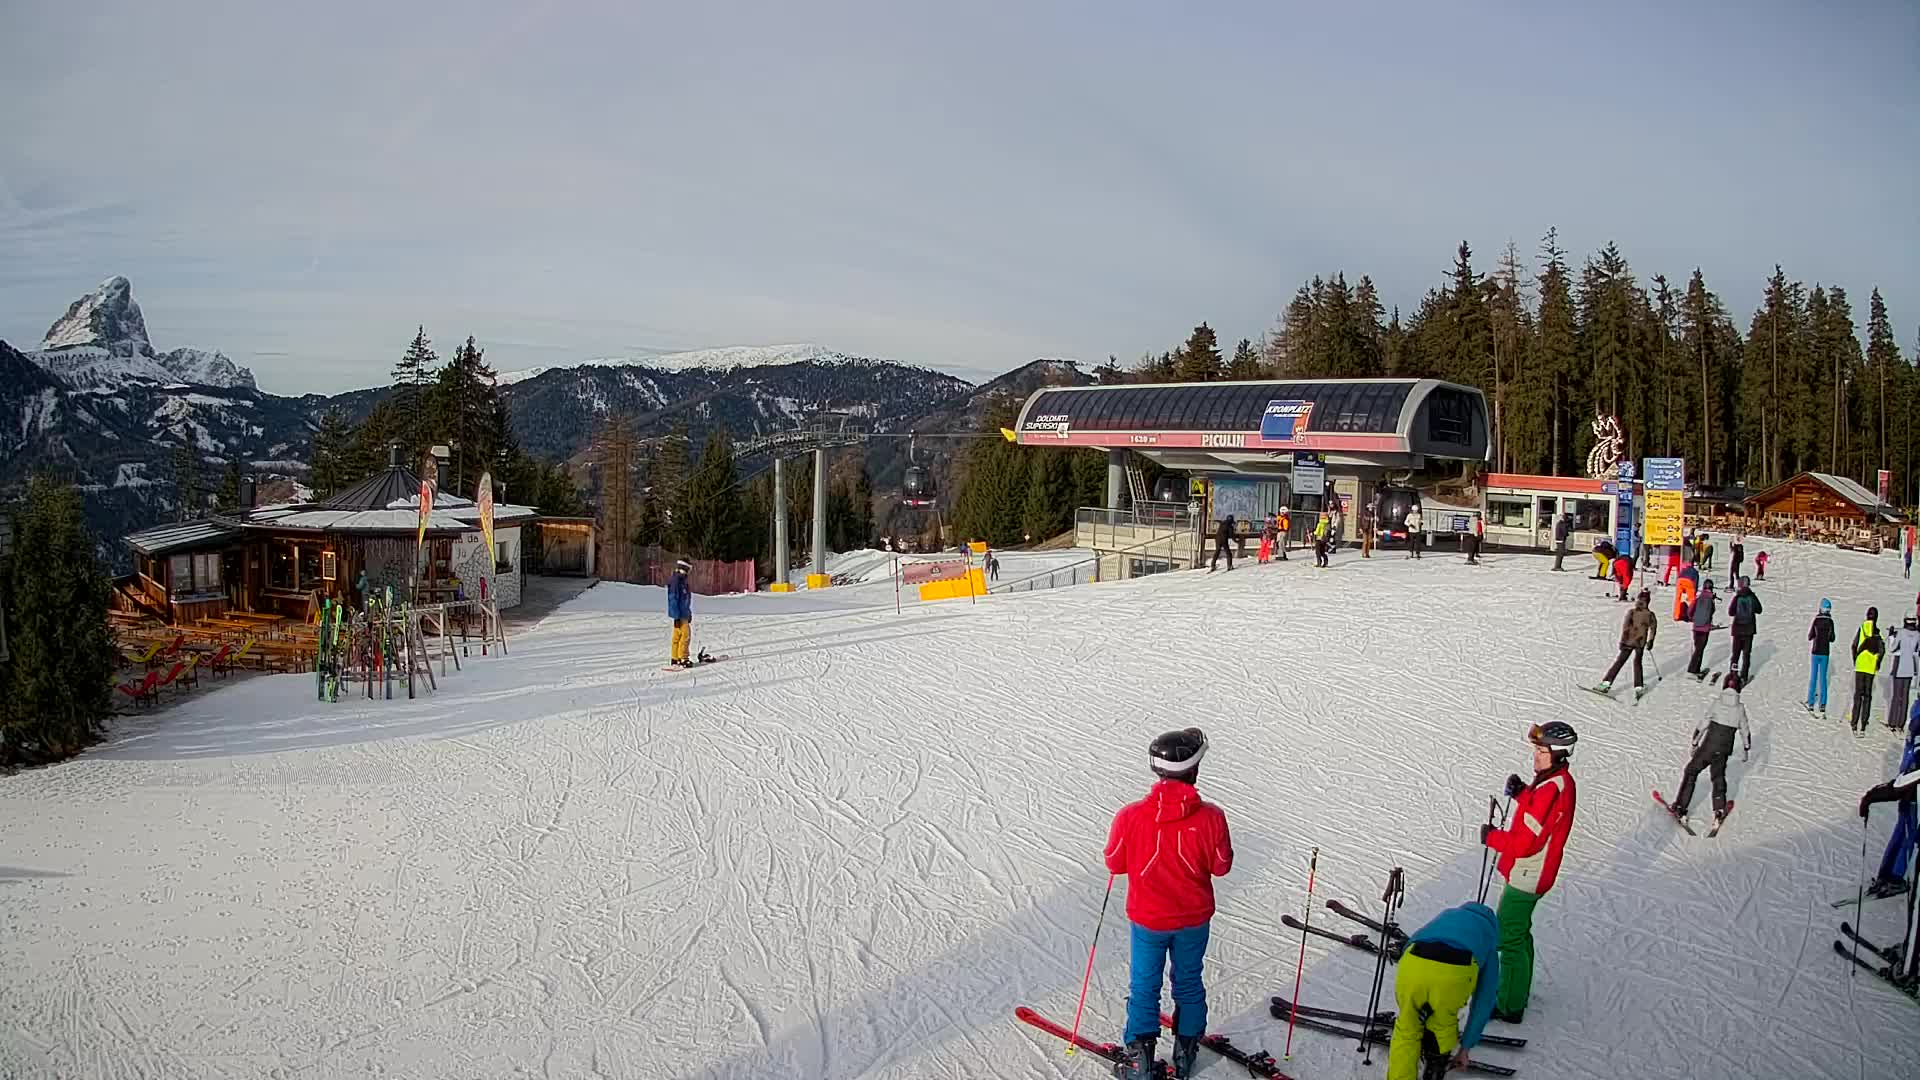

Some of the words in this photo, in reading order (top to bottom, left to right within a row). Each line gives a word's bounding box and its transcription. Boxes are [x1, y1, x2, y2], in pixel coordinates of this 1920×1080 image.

[1266, 405, 1311, 414] KRONPLATZ
[1025, 422, 1058, 430] SUPERSKI
[1201, 434, 1245, 448] PICULIN
